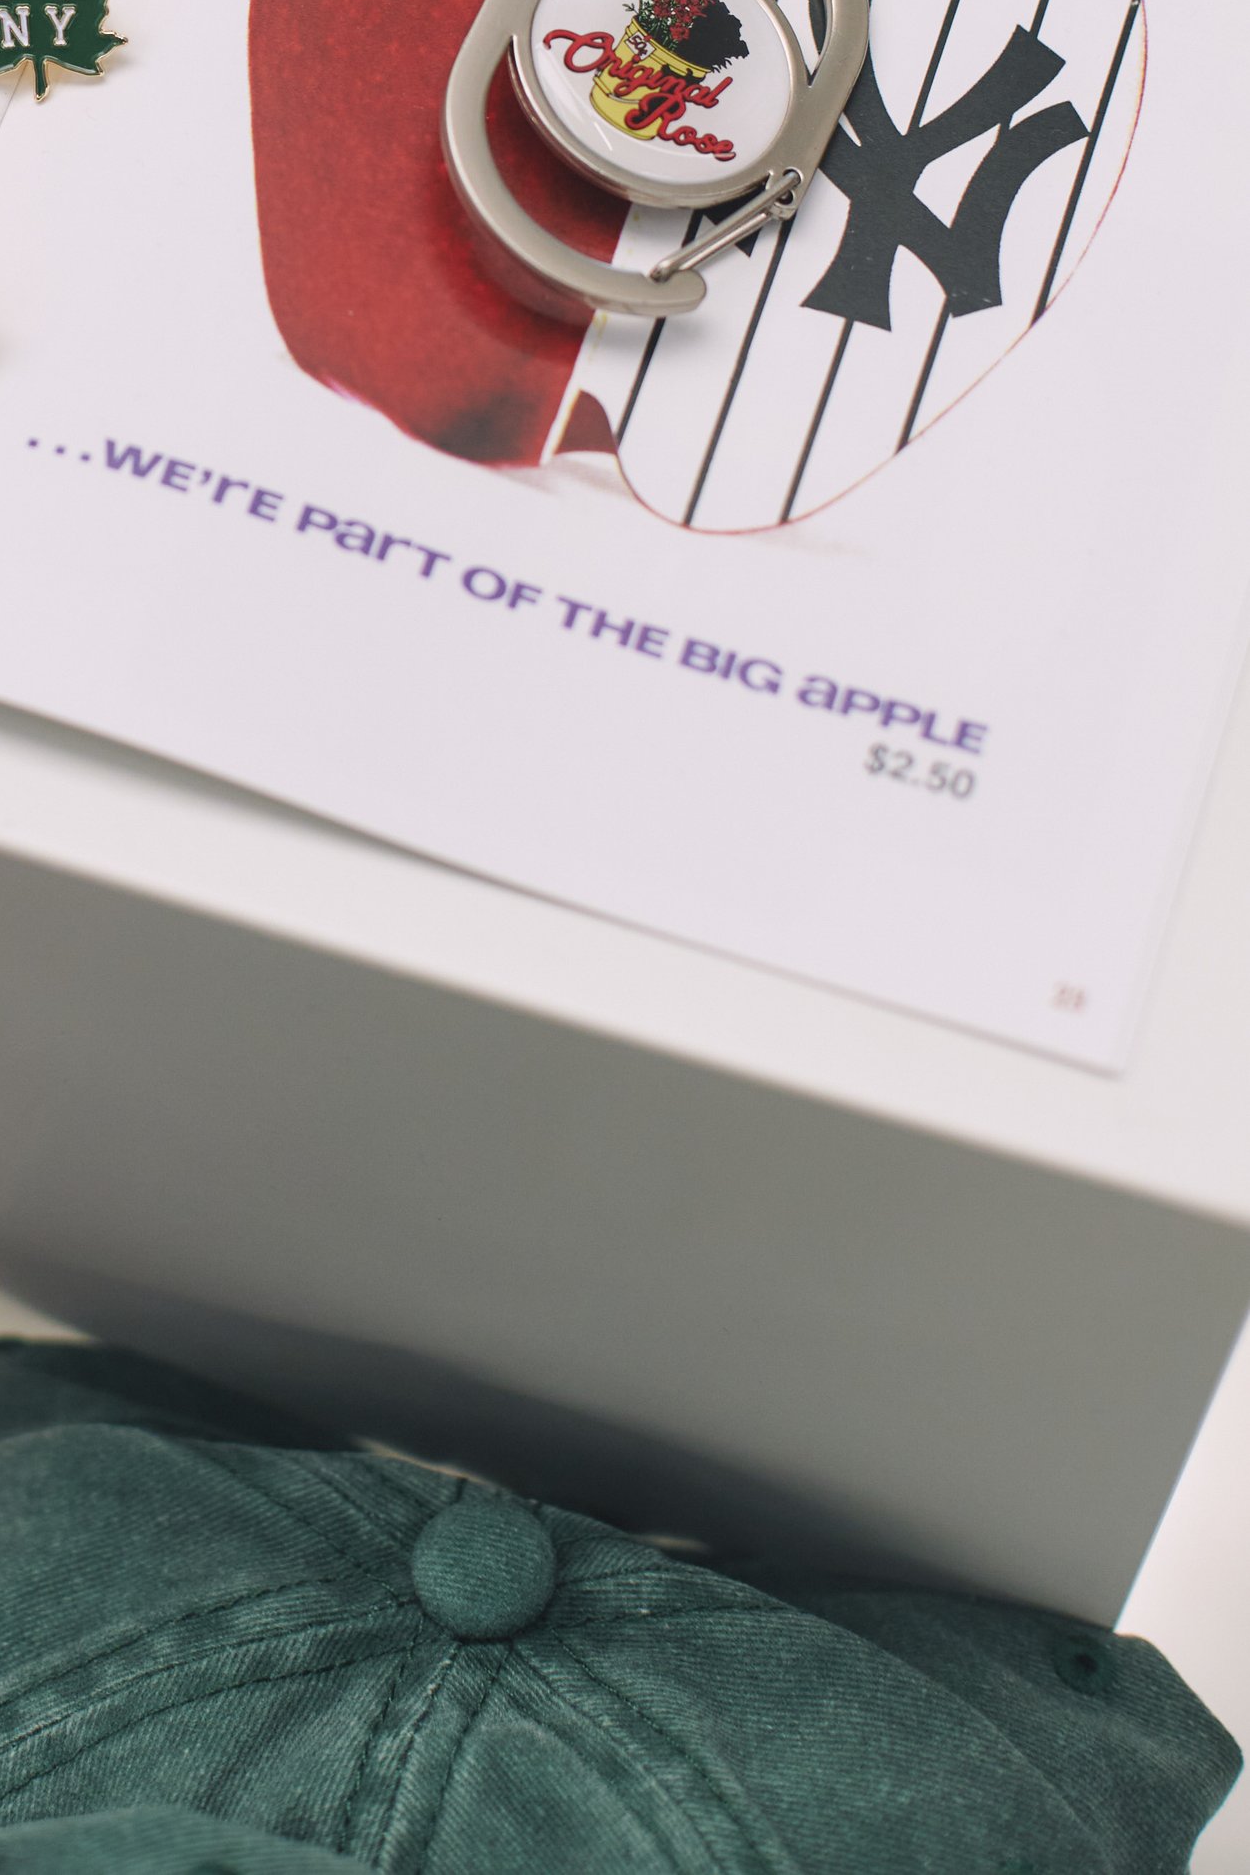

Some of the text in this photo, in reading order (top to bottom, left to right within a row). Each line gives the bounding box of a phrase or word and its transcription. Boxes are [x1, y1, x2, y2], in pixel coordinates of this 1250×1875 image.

[543, 29, 734, 109] Original
[624, 92, 737, 162] Rose
[460, 562, 544, 613] OF
[553, 593, 671, 663] THE
[677, 635, 785, 696] BIG
[865, 742, 977, 802] $2.50
